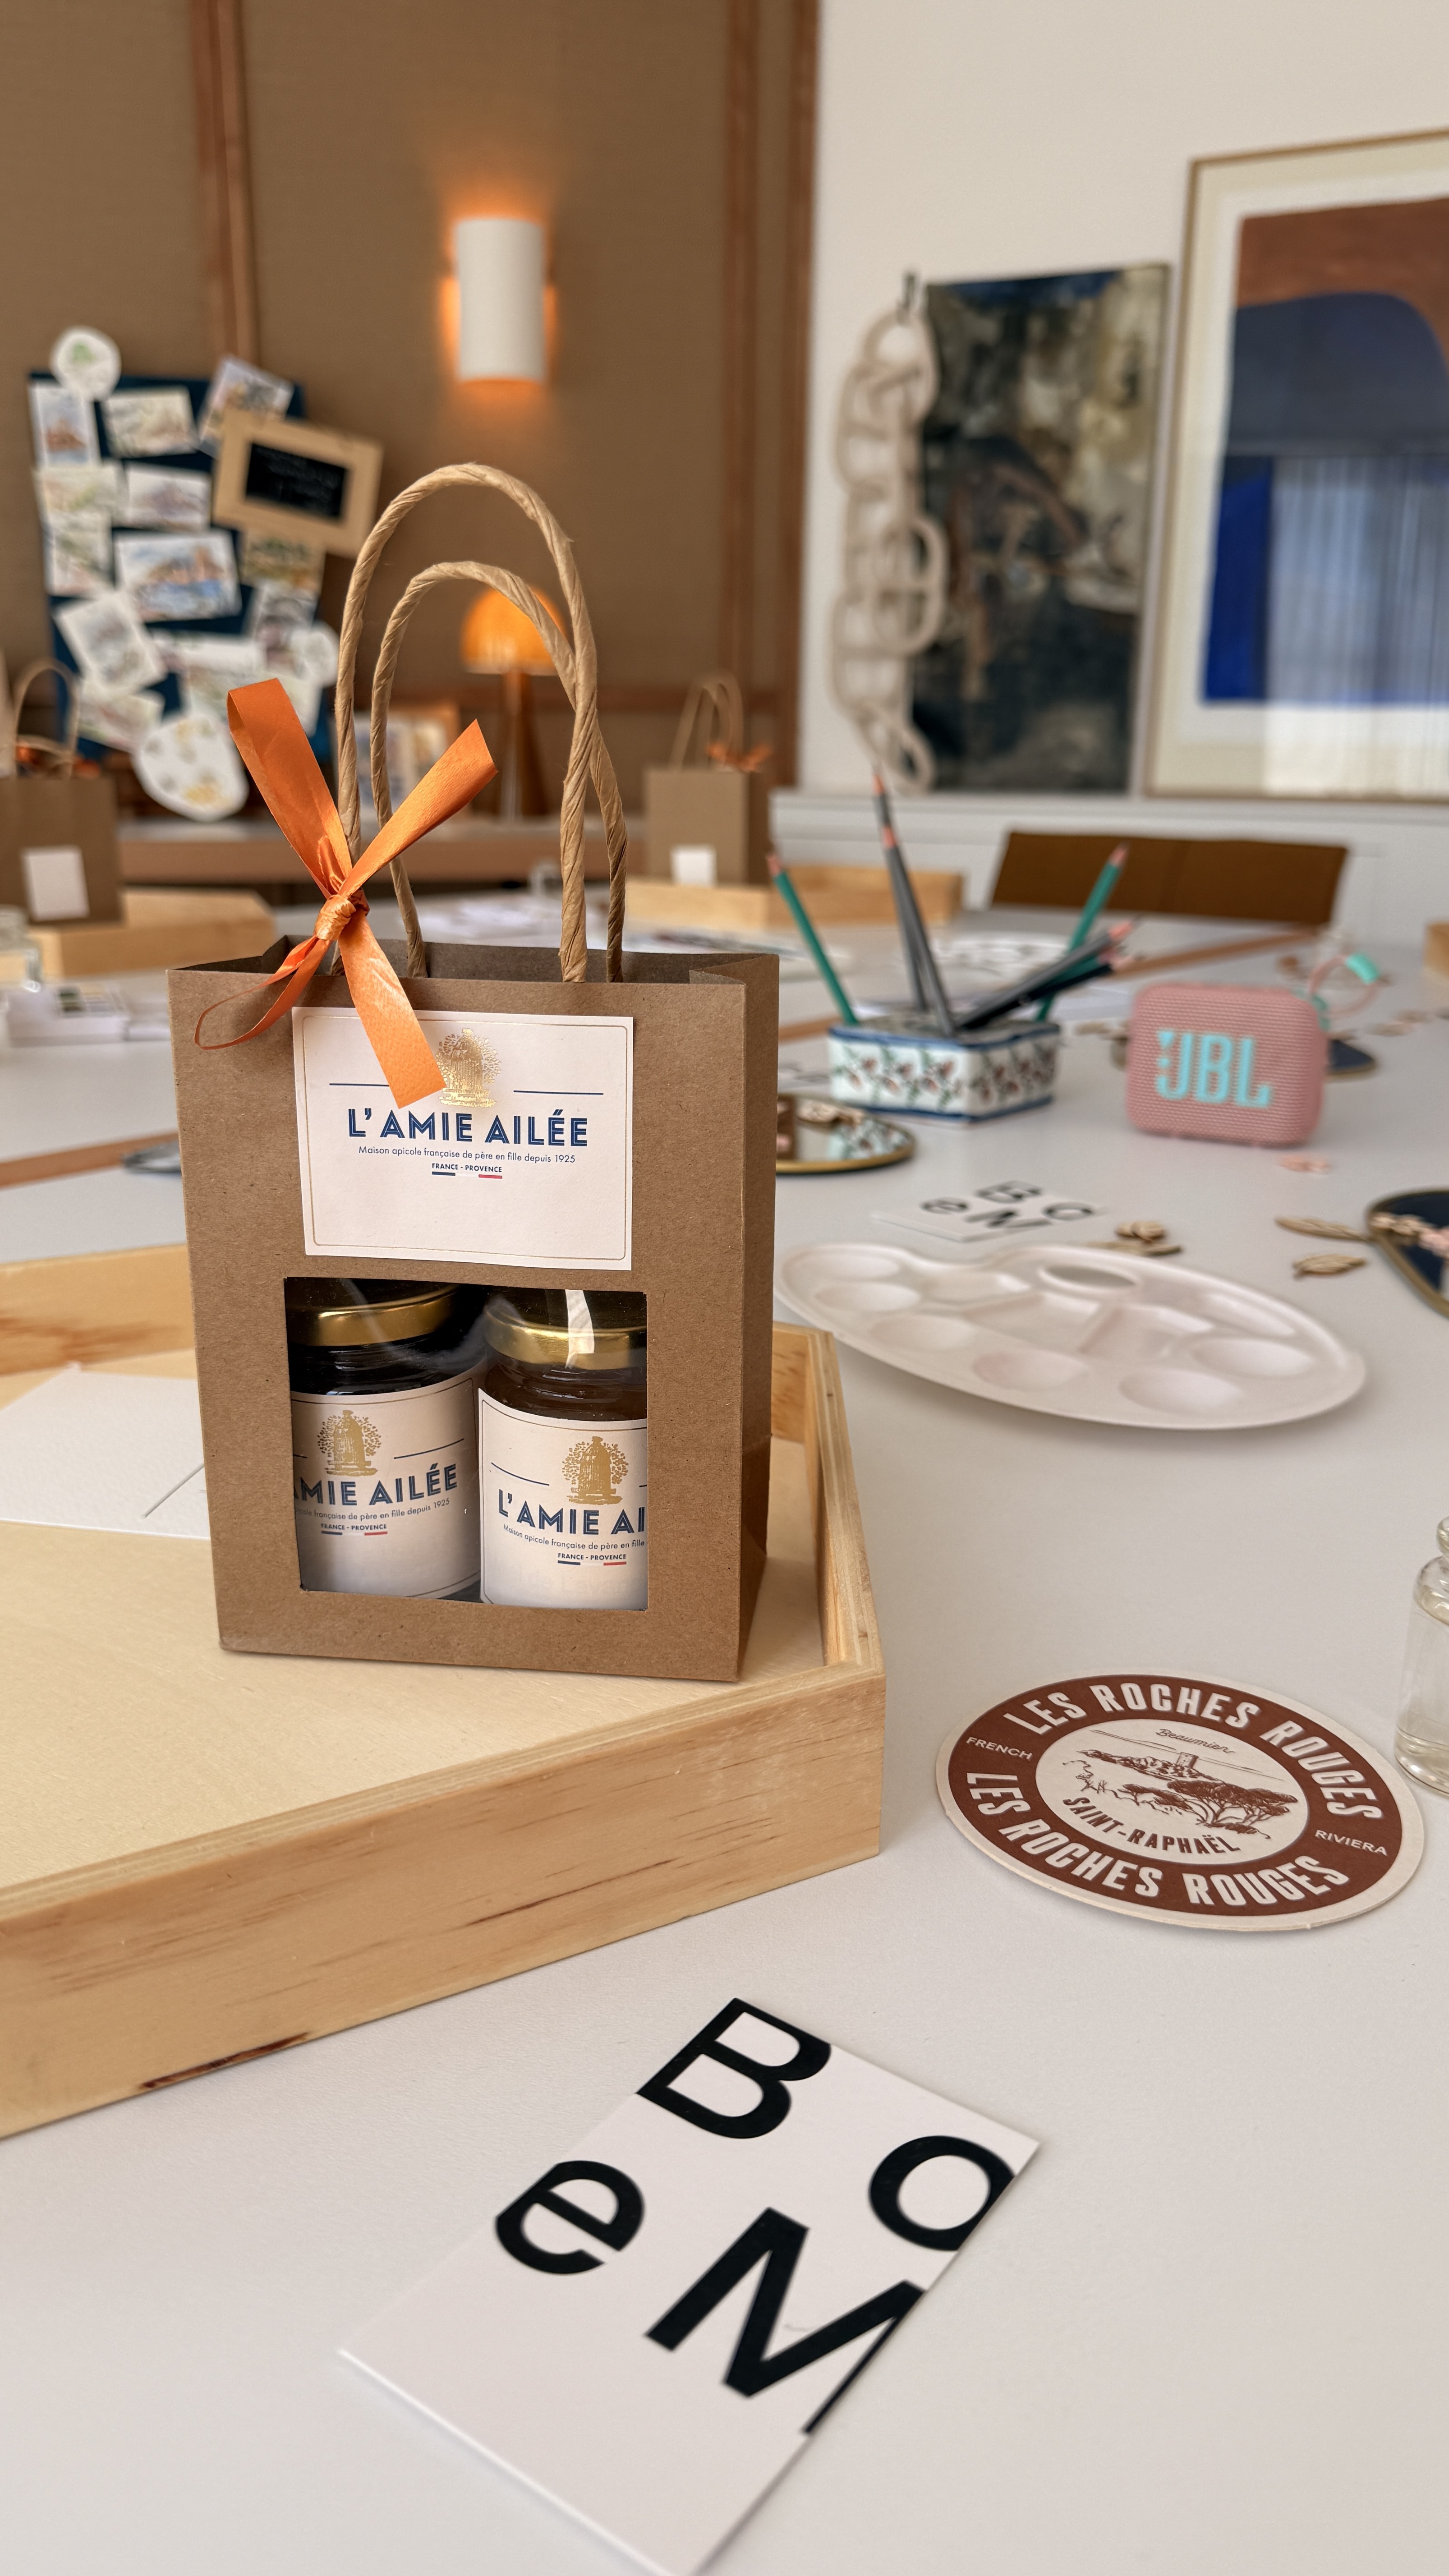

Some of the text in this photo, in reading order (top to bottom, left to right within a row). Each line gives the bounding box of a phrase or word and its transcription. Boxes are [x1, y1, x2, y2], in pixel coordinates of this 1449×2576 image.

[1155, 1029, 1272, 1109] JBL
[485, 1109, 587, 1146] AILÉE
[359, 1146, 389, 1154] Maison
[392, 1147, 421, 1156] apicole
[424, 1148, 460, 1158] française
[475, 1152, 492, 1160] père
[508, 1152, 522, 1161] fille
[524, 1154, 551, 1163] depuis
[555, 1155, 575, 1163] 1925
[294, 1463, 457, 1505] MIE AILÉE
[314, 1510, 346, 1520] française
[360, 1513, 377, 1521] père
[407, 1506, 431, 1515] depuis
[433, 1498, 450, 1509] 1925
[503, 1523, 523, 1537] Maison
[524, 1534, 549, 1545] apicole
[552, 1538, 586, 1549] française
[601, 1542, 618, 1551] père
[632, 1539, 644, 1547] fille
[966, 1737, 1033, 1759] FRENCH
[1003, 1683, 1384, 1819] LES ROCHES ROUGES
[1156, 1729, 1235, 1753] Beaumier
[966, 1773, 1349, 1906] LES ROCHES ROUGES
[1062, 1797, 1241, 1855] SAINT-RAPHAËL
[1315, 1830, 1388, 1857] RIVIERA
